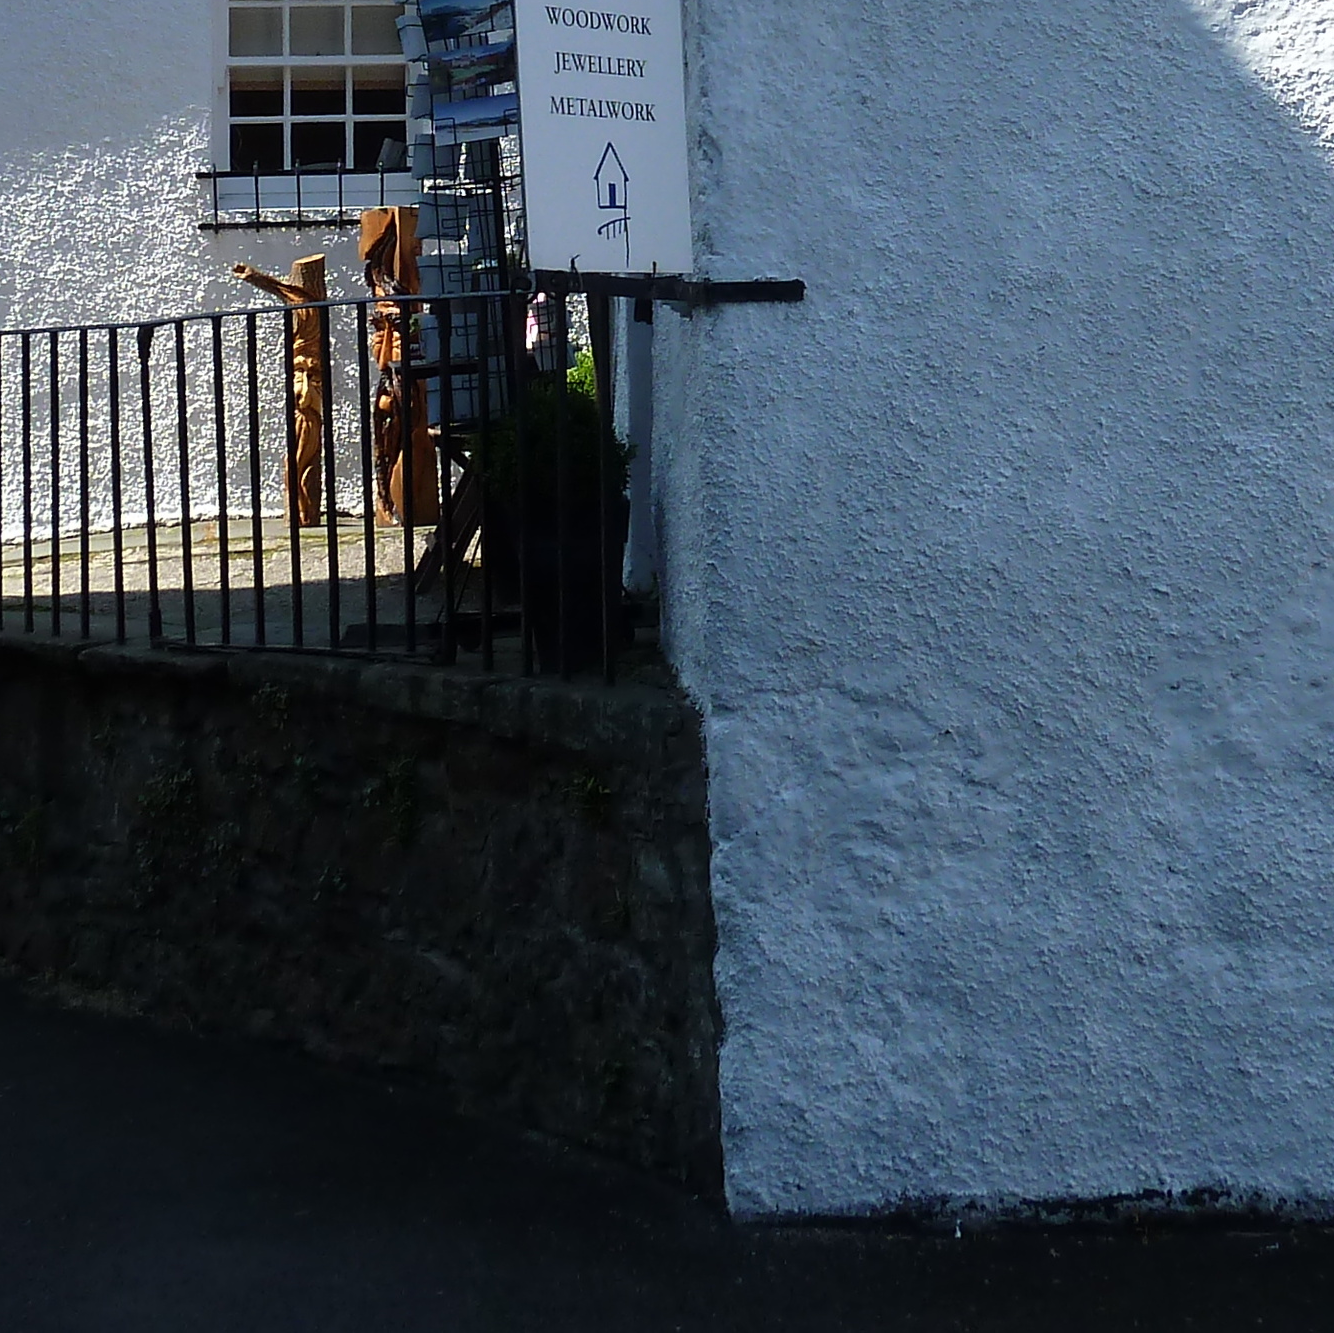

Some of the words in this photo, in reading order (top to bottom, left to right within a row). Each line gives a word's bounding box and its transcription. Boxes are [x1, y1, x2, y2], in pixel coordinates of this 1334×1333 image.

[545, 5, 652, 36] WOODWORK
[554, 51, 647, 78] JEWELLERY
[550, 95, 656, 122] METALWORK
